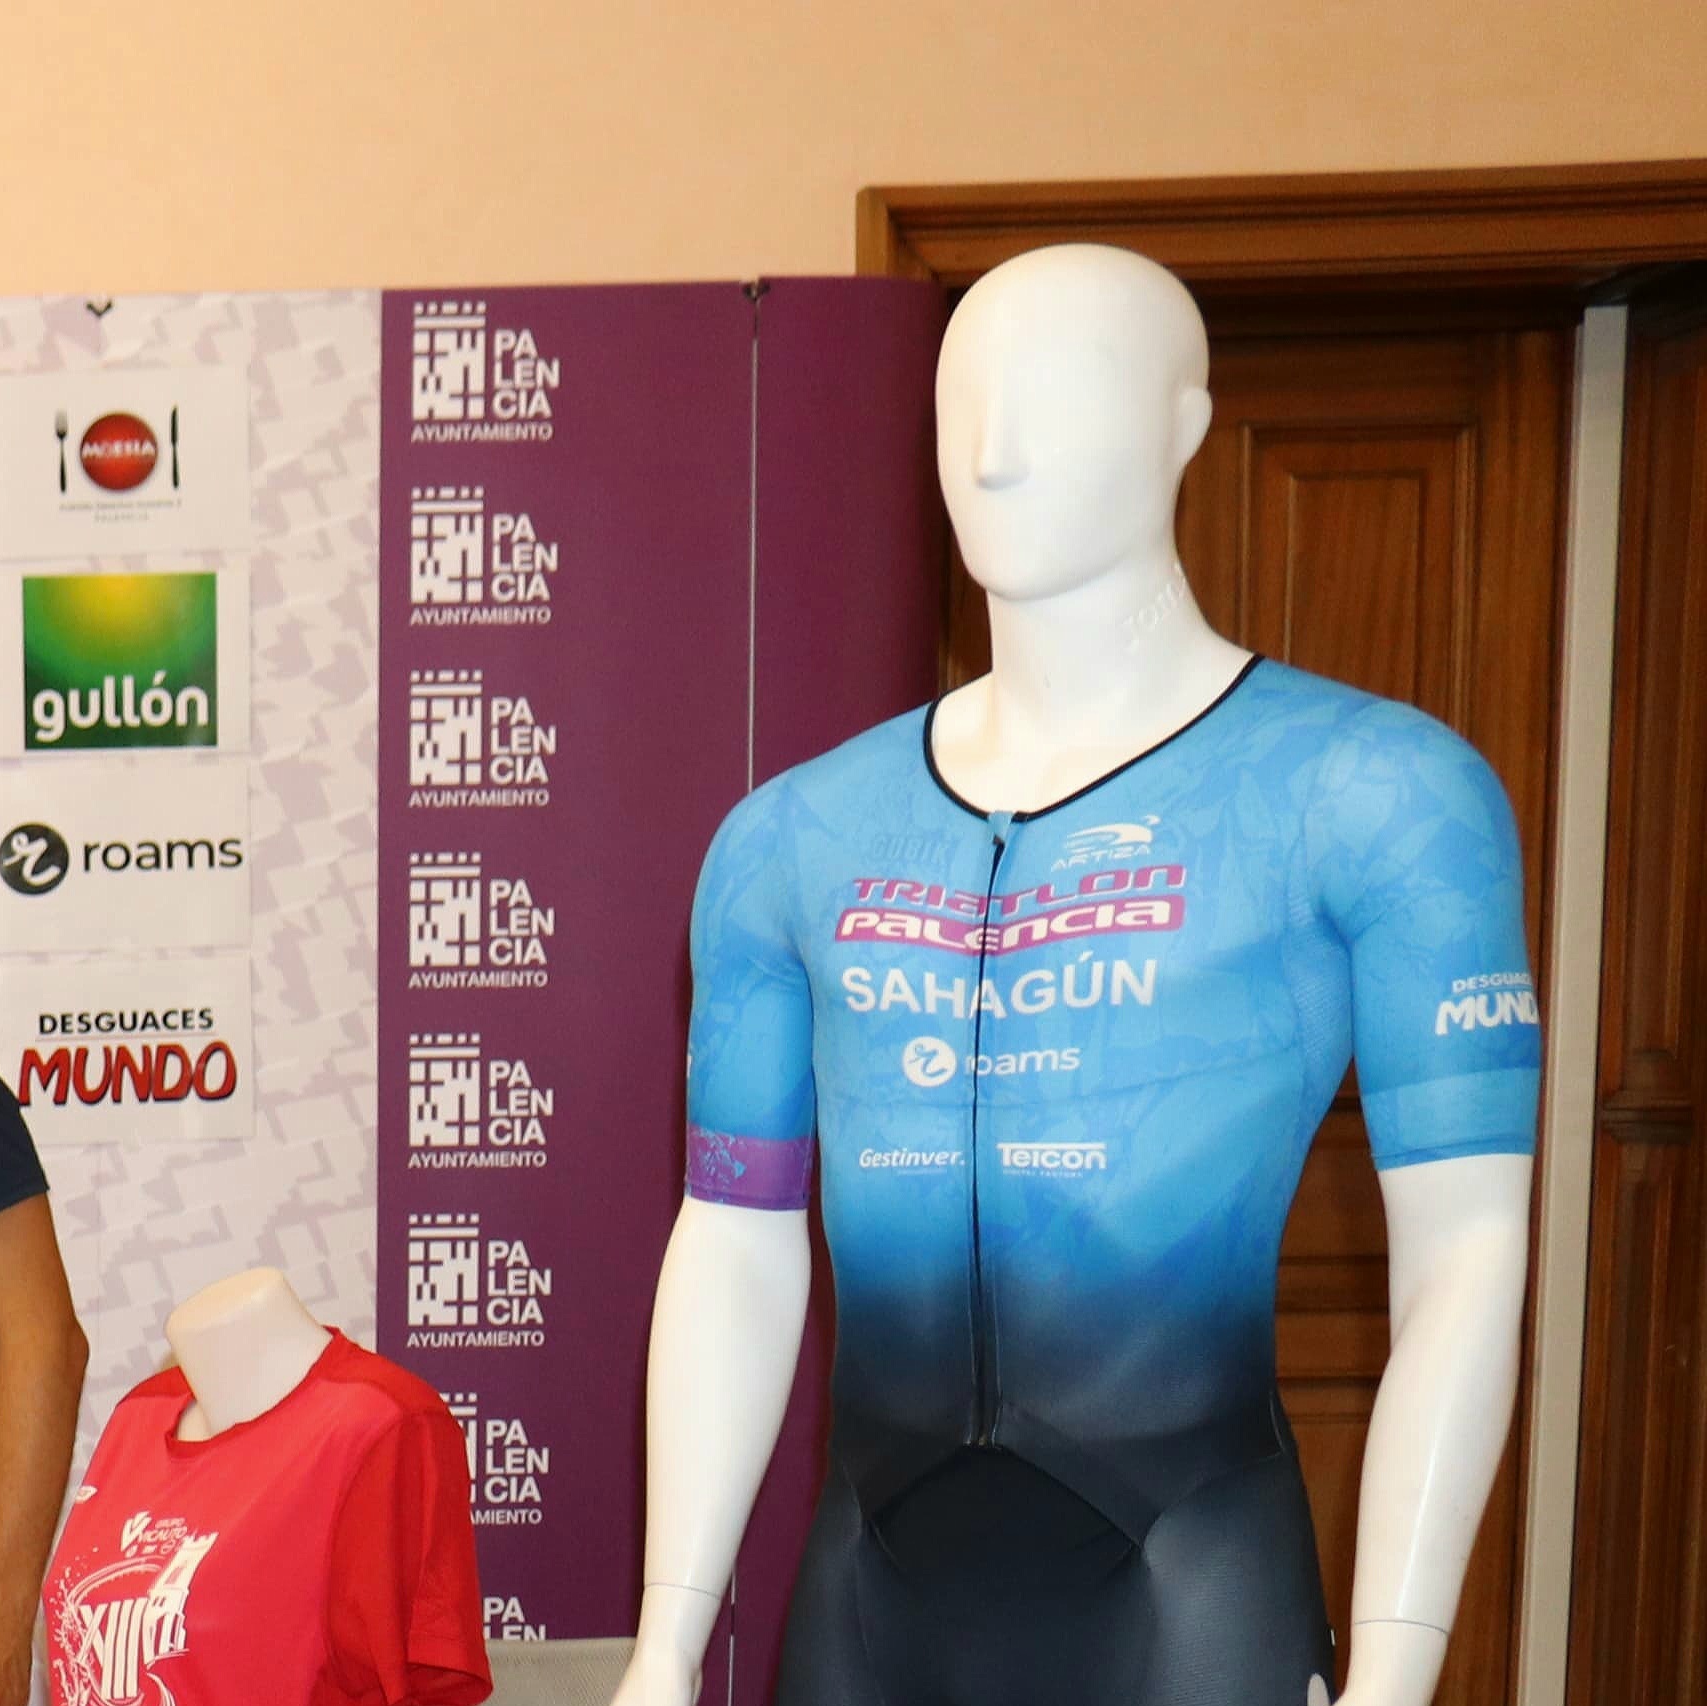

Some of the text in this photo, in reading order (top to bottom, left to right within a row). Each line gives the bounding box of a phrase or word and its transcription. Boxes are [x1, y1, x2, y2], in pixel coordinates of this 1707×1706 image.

[494, 329, 538, 358] PA
[494, 360, 560, 387] LEN
[492, 391, 552, 418] CIA
[411, 423, 553, 442] AYUNTAMIENTO
[493, 515, 536, 543] PA
[492, 544, 558, 572] LEN
[492, 574, 550, 602] CIA
[410, 608, 551, 626] AYUNTAMIENTO
[32, 671, 209, 742] gullón
[492, 698, 534, 725] PA
[492, 727, 556, 755] LEN
[490, 757, 548, 784] CIA
[410, 790, 549, 808] AYUNTAMIENTO
[83, 838, 243, 873] roams
[490, 880, 532, 908] PA
[490, 909, 554, 936] LEN
[489, 938, 547, 965] CIA
[409, 971, 547, 988] AYUNTAMIENTO
[841, 951, 1158, 1020] SAHAGÚN
[39, 1008, 214, 1035] DESGUACES
[18, 1040, 237, 1105] MUNDO
[489, 1061, 532, 1088] PA
[965, 1046, 1081, 1076] roams
[489, 1090, 554, 1117] LEN
[489, 1119, 546, 1146] CIA
[408, 1151, 546, 1169] AYUNTAMIENTO
[859, 1146, 965, 1169] Gestinver.
[488, 1241, 531, 1268] PA
[488, 1270, 552, 1296] LEN
[486, 1298, 544, 1325] CIA
[407, 1331, 544, 1348] AYUNTAMIENTO
[486, 1420, 528, 1446] PA
[486, 1448, 549, 1475] LEN
[485, 1476, 541, 1503] CIA
[484, 1597, 525, 1623] PA
